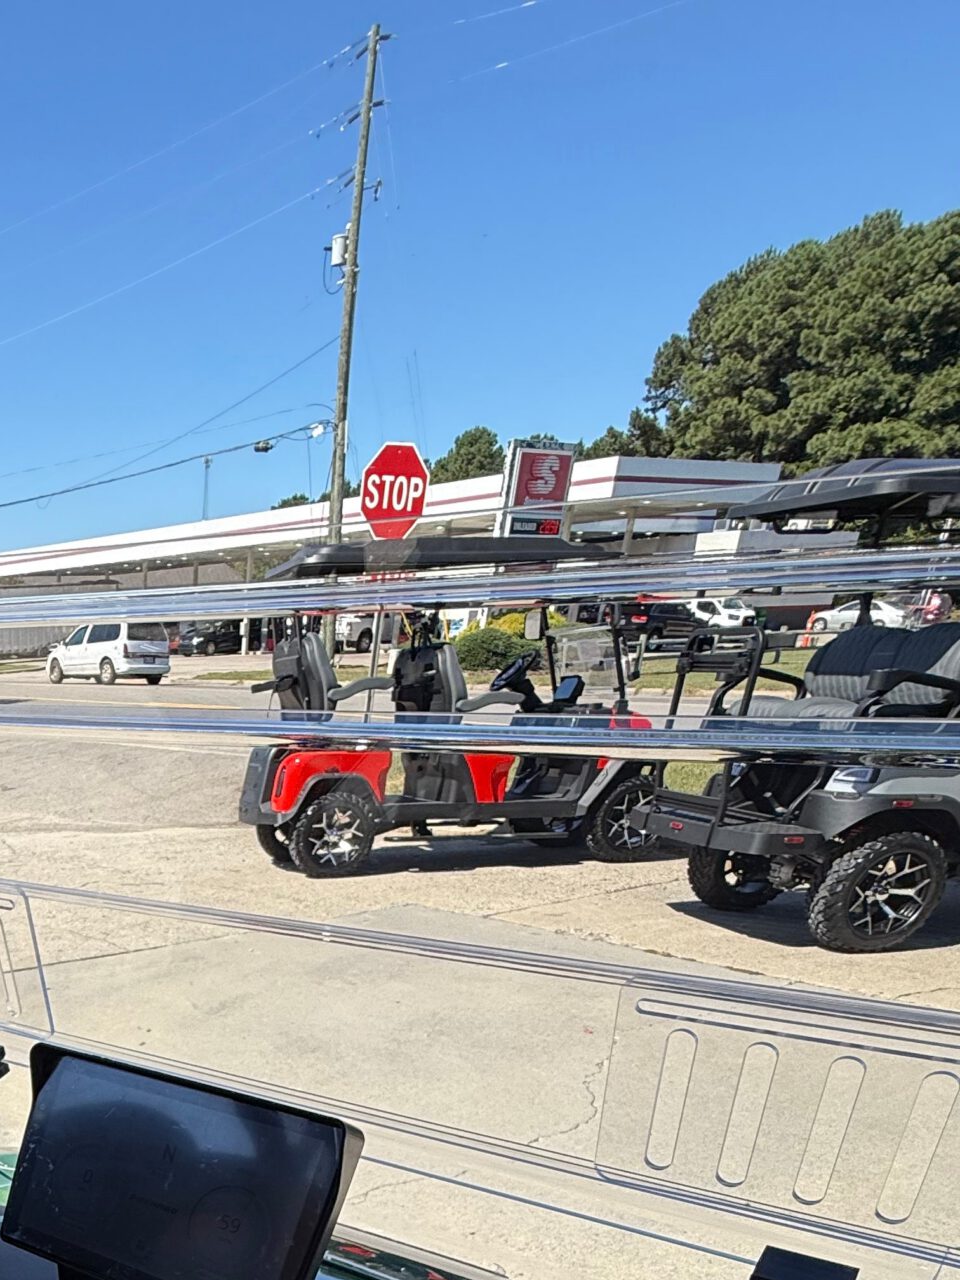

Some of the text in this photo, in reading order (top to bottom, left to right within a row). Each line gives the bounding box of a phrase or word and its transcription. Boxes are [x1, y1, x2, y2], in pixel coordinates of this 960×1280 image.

[365, 474, 424, 512] STOP
[163, 1144, 177, 1163] N
[217, 1215, 241, 1233] 59
